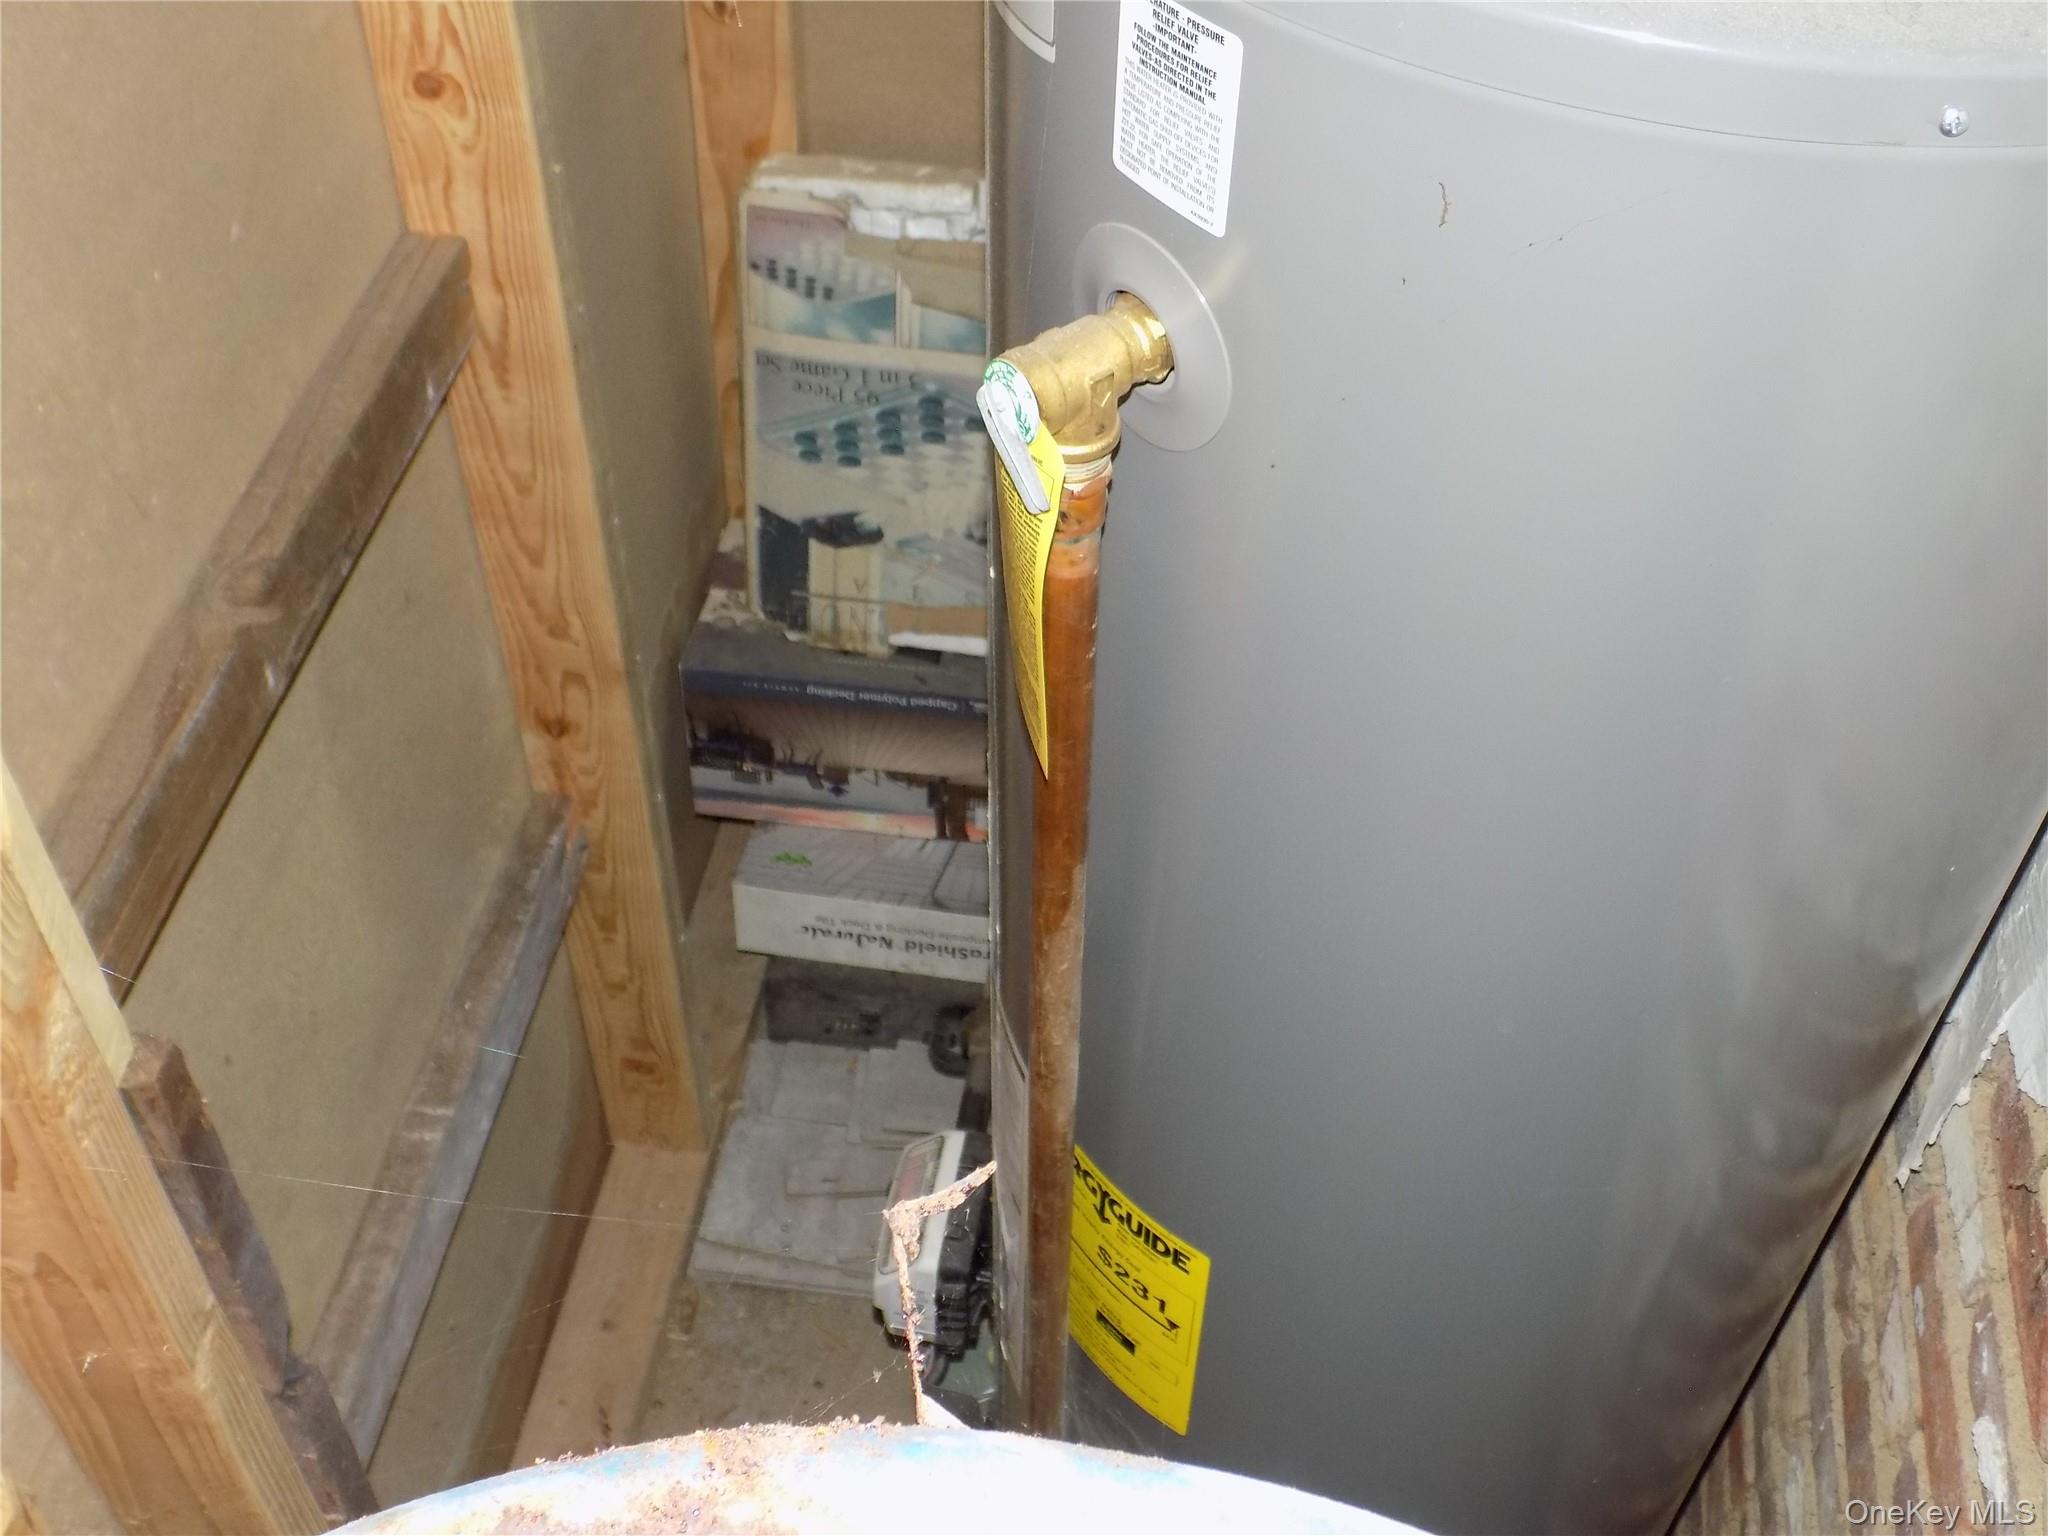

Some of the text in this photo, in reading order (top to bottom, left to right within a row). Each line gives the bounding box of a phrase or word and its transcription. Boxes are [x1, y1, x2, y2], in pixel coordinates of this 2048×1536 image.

[1150, 0, 1179, 20] RATURE
[1187, 16, 1224, 46] PRESSURE
[1152, 8, 1198, 44] RELIEF VALVE
[1134, 21, 1216, 80] FOLLOW THE MAINTENANCE
[1136, 33, 1212, 88] PROCEDURES FOR RELIEF
[1129, 70, 1160, 98] TEMPERATURE
[1163, 94, 1174, 107] AND
[1175, 101, 1201, 123] PRESSURE
[1203, 118, 1220, 134] RELIEF
[1136, 64, 1151, 81] WATER
[1153, 76, 1171, 94] HEATER
[1179, 93, 1206, 115] PROVIDED
[1208, 110, 1222, 125] WITH
[1138, 56, 1206, 105] INSTRUCTION MANUAL
[1163, 62, 1193, 87] DIRECTED
[1195, 81, 1201, 92] IN
[1204, 87, 1216, 101] THE
[1122, 106, 1130, 119] HOT
[1134, 116, 1149, 132] WATER
[1153, 129, 1170, 146] SUPPLY
[1122, 97, 1147, 120] AUTOMATIC
[1148, 115, 1158, 128] GAS
[1184, 138, 1206, 158] DEVICES
[1207, 153, 1218, 165] FOR
[1123, 77, 1219, 144] VALVE LISTED AS COMPLYING WITH THE
[1149, 106, 1159, 118] FOR
[1163, 115, 1179, 131] RELIEF
[1184, 128, 1203, 145] VALVES
[1208, 142, 1219, 155] AND
[1121, 126, 1135, 142] WATER
[1173, 163, 1188, 178] RELIEF
[1136, 147, 1145, 159] NOT
[1159, 163, 1183, 184] REMOVED
[1187, 181, 1201, 196] FROM
[1138, 129, 1148, 141] FOR
[1165, 147, 1192, 170] OPERATION
[1195, 166, 1201, 176] OF
[1147, 165, 1160, 180] POINT
[1162, 176, 1168, 185] OF
[1171, 181, 1204, 208] INSTALLATION
[1206, 203, 1213, 213] OR
[788, 359, 848, 383] Game
[791, 378, 842, 402] Piece
[806, 684, 855, 701] Decking
[859, 691, 907, 707] Polymer
[910, 697, 957, 711] Capped
[1097, 1245, 1167, 1315] $231
